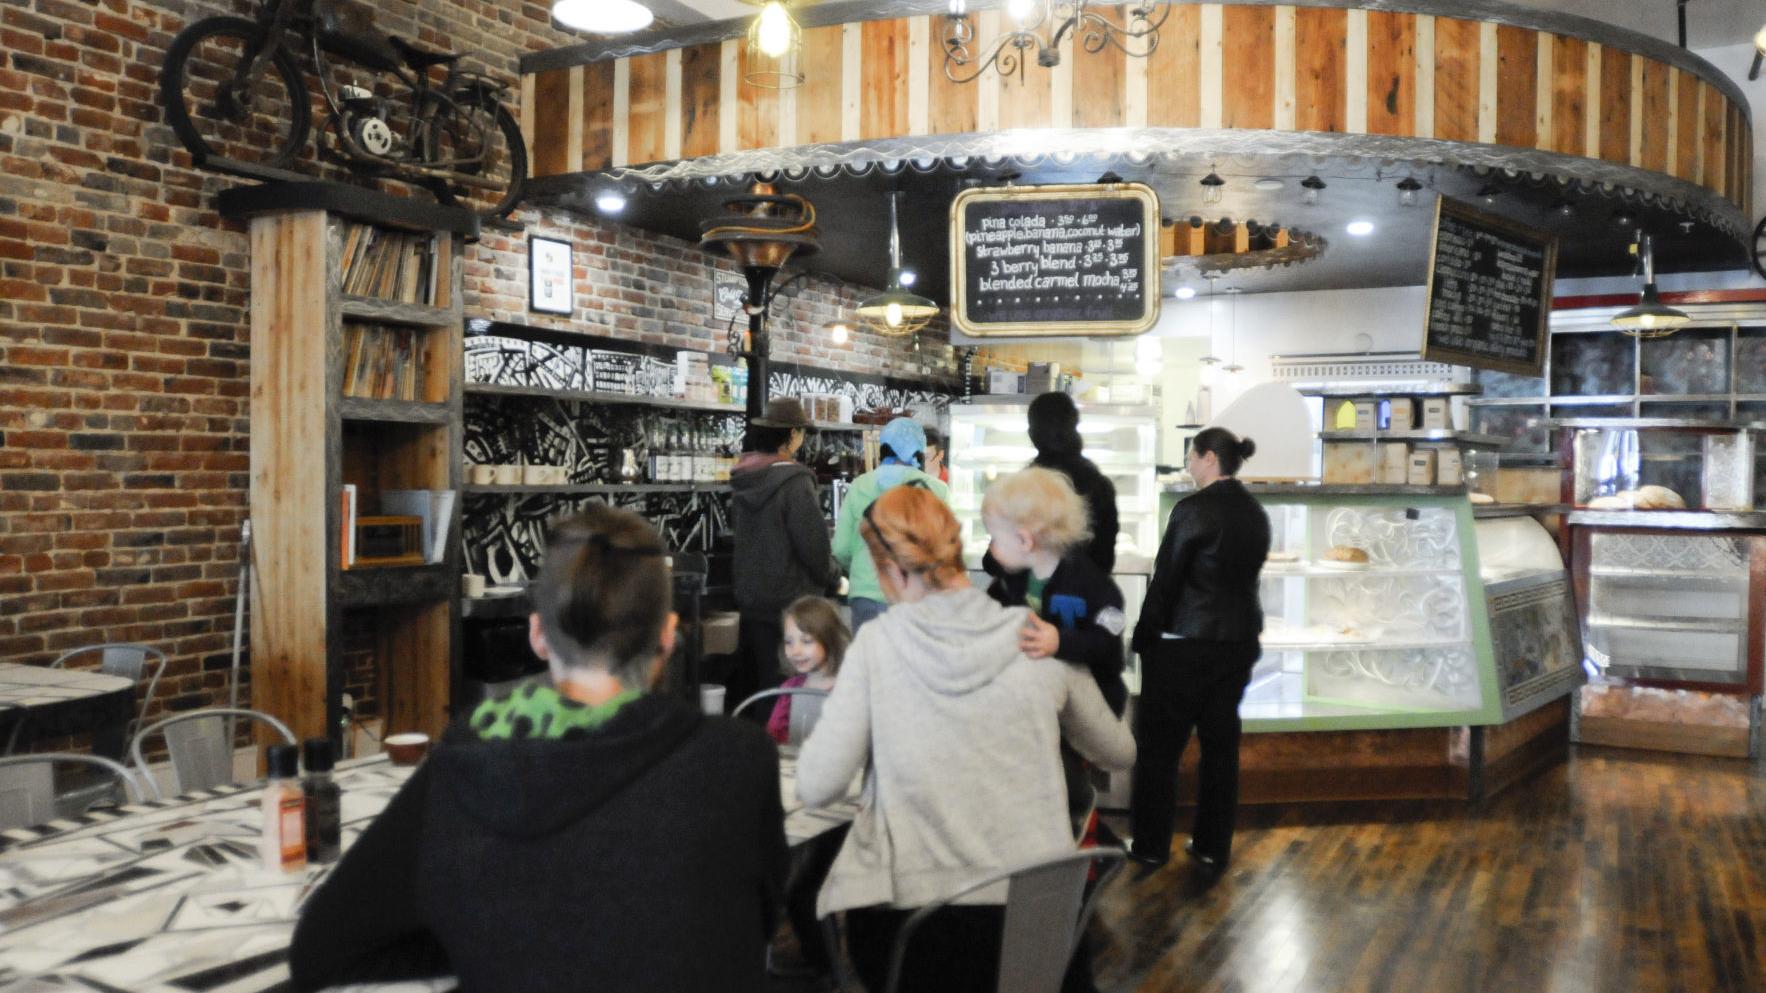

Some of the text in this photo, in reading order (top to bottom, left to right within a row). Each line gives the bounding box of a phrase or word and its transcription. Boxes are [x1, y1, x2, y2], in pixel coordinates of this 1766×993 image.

[981, 217, 1006, 231] pina
[1008, 214, 1046, 228] colada
[1107, 222, 1141, 237] water)
[976, 241, 1040, 258] strawberry
[1042, 239, 1083, 254] banana
[990, 260, 999, 276] 3
[1001, 259, 1039, 277] berry
[1040, 254, 1077, 270] blend
[979, 274, 1033, 292] blended
[1034, 271, 1080, 288] carmel
[1082, 270, 1120, 287] mocha
